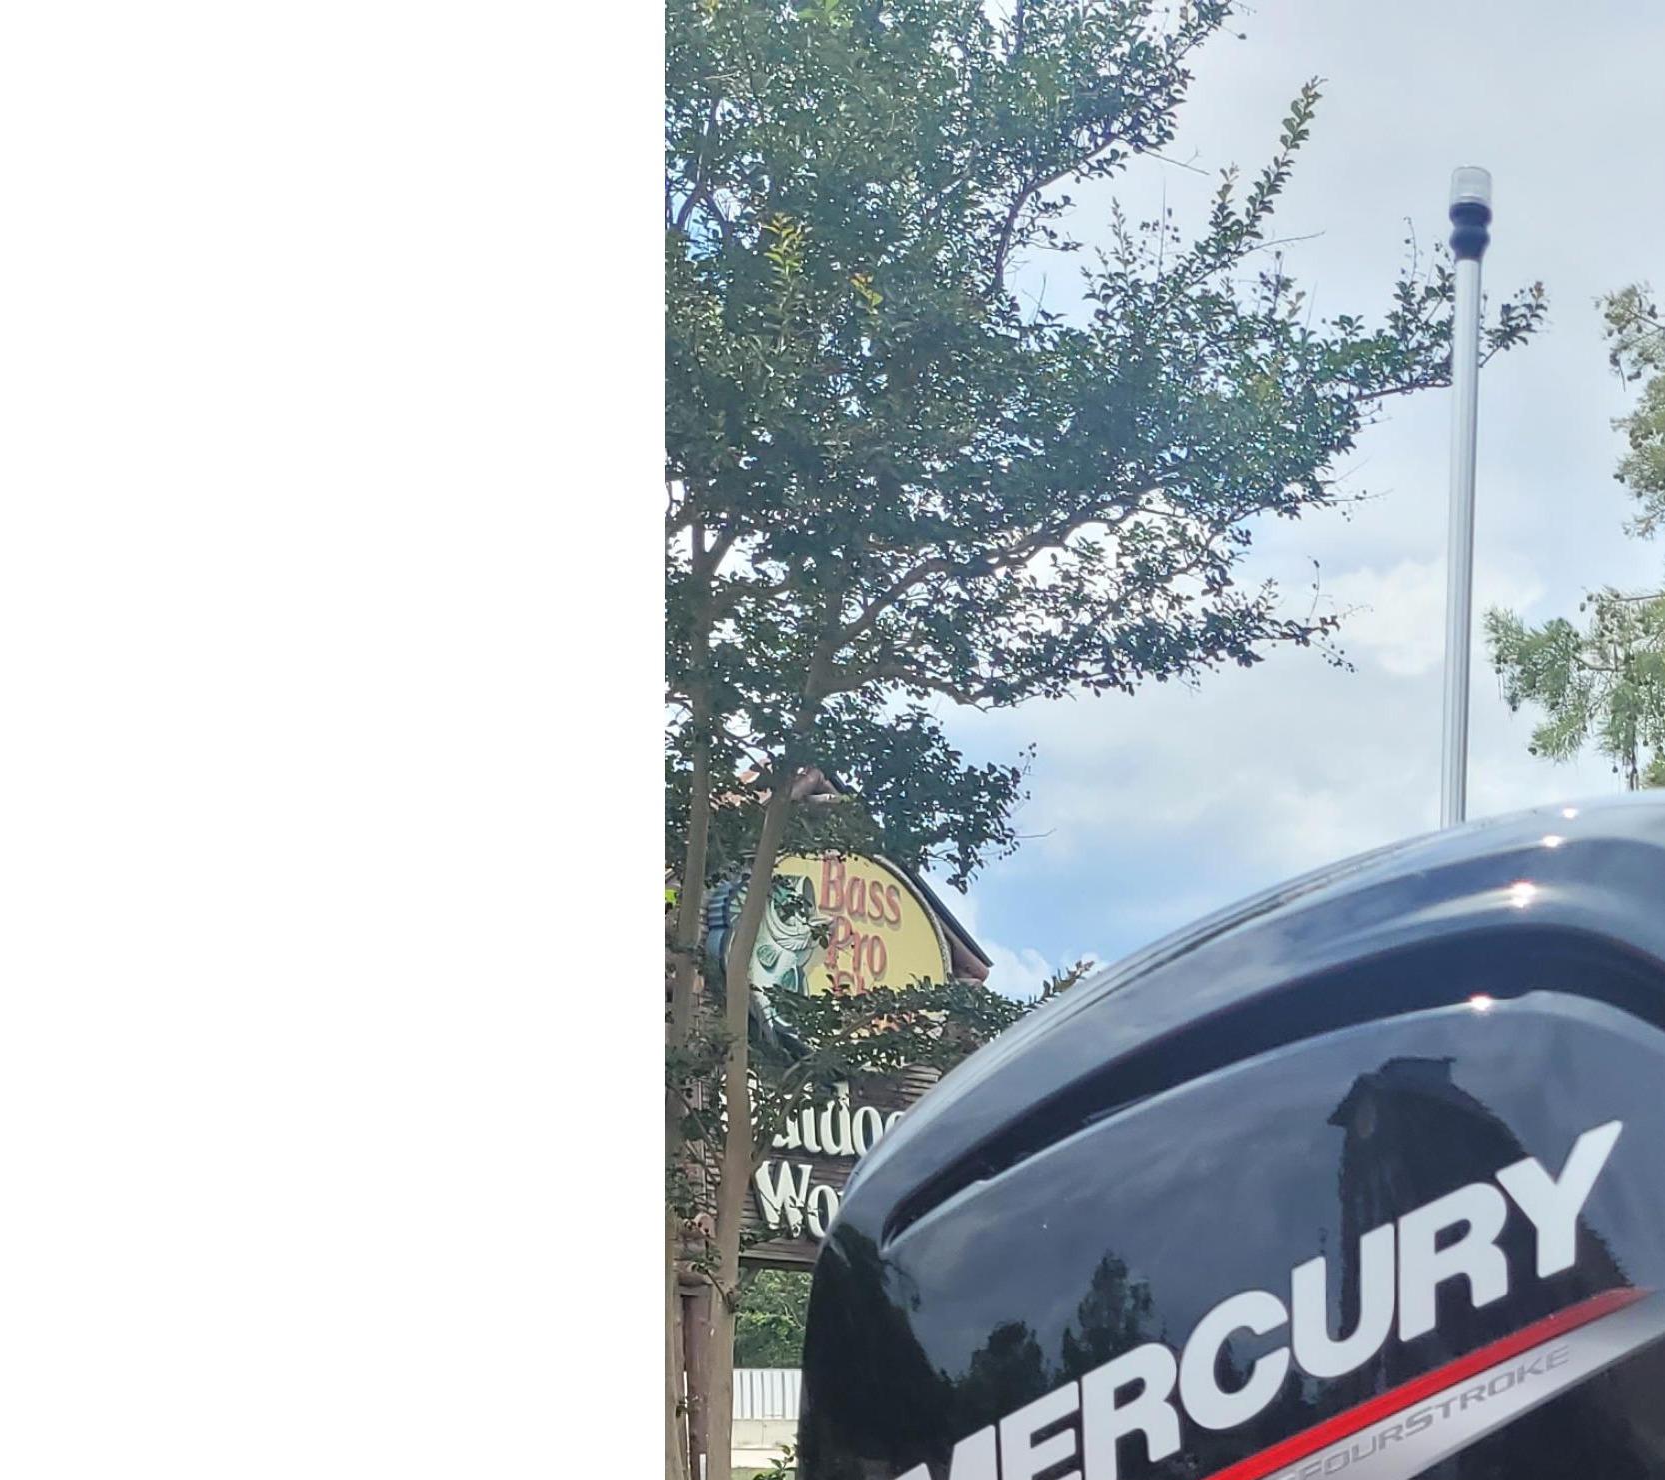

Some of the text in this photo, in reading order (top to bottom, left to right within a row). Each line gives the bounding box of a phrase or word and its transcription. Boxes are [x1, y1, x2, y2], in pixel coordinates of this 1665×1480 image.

[819, 849, 901, 926] Bass
[824, 914, 887, 977] Pro
[755, 1160, 844, 1238] Wo
